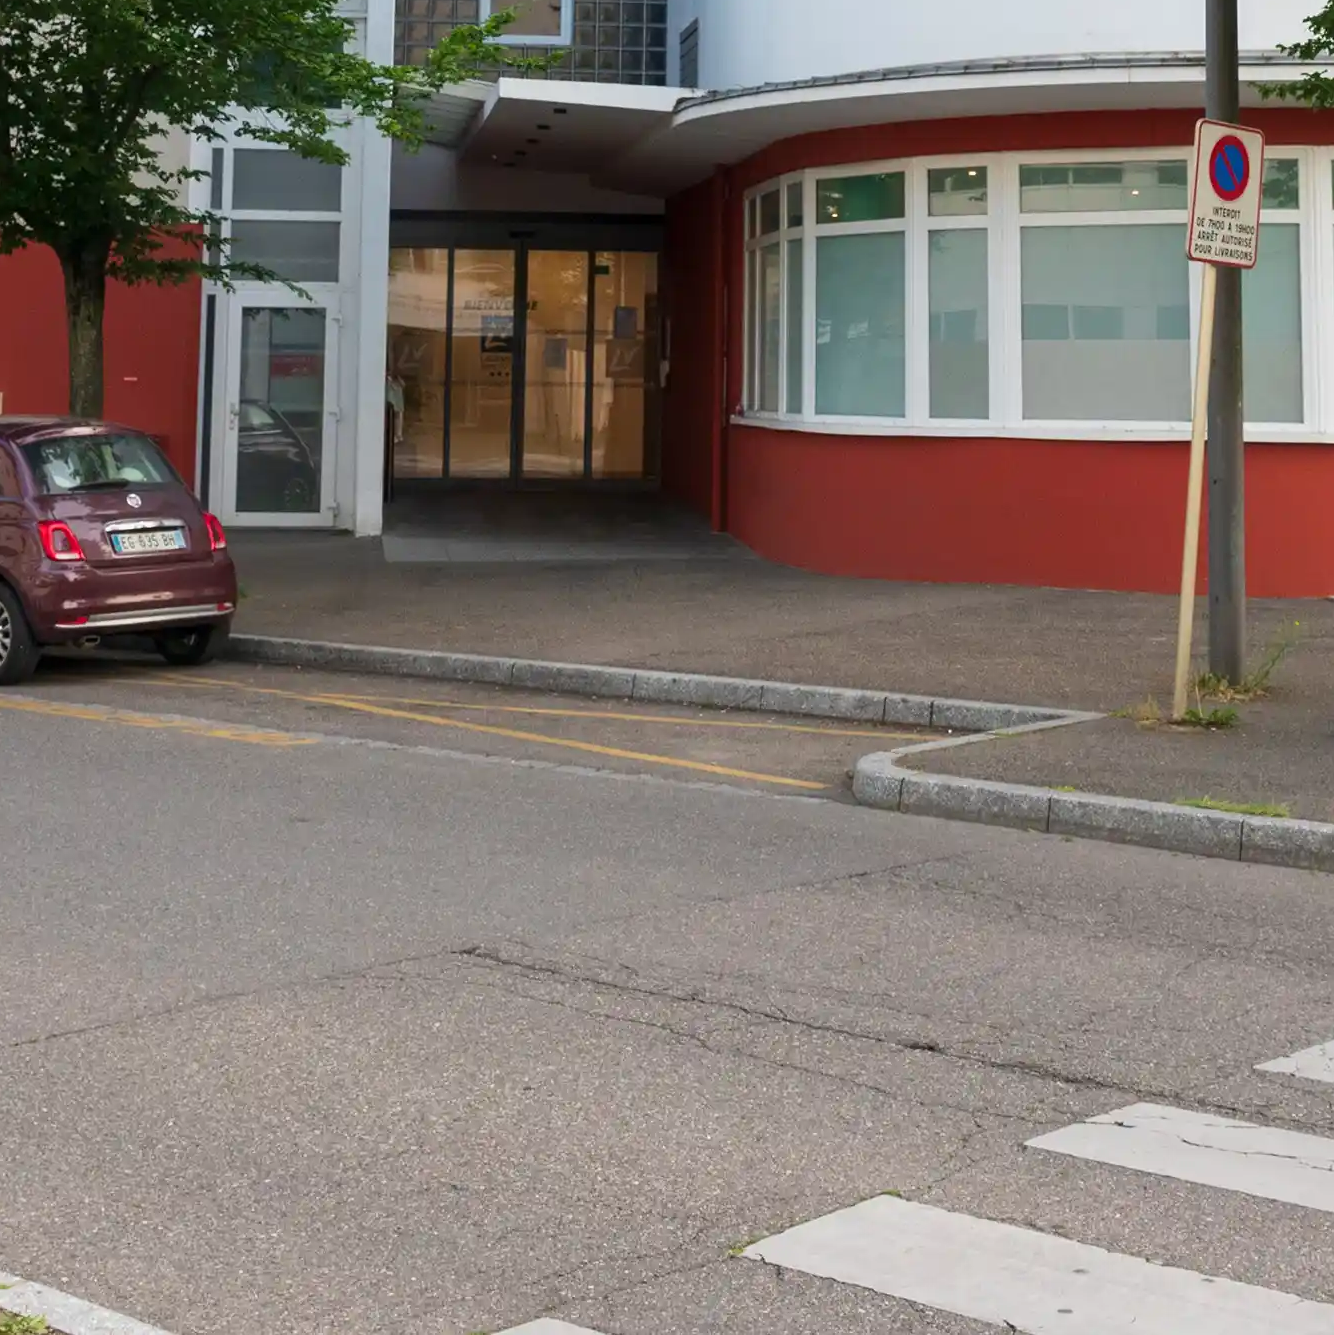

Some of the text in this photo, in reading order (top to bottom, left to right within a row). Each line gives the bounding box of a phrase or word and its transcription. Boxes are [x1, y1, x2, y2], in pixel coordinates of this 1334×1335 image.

[1212, 206, 1241, 220] INTERDIT
[1196, 216, 1205, 227] DE
[1208, 218, 1225, 231] 7H00
[1235, 223, 1255, 235] 19H00
[1197, 229, 1218, 242] ARRÊT
[1194, 243, 1254, 262] POUR LIVRAISONS
